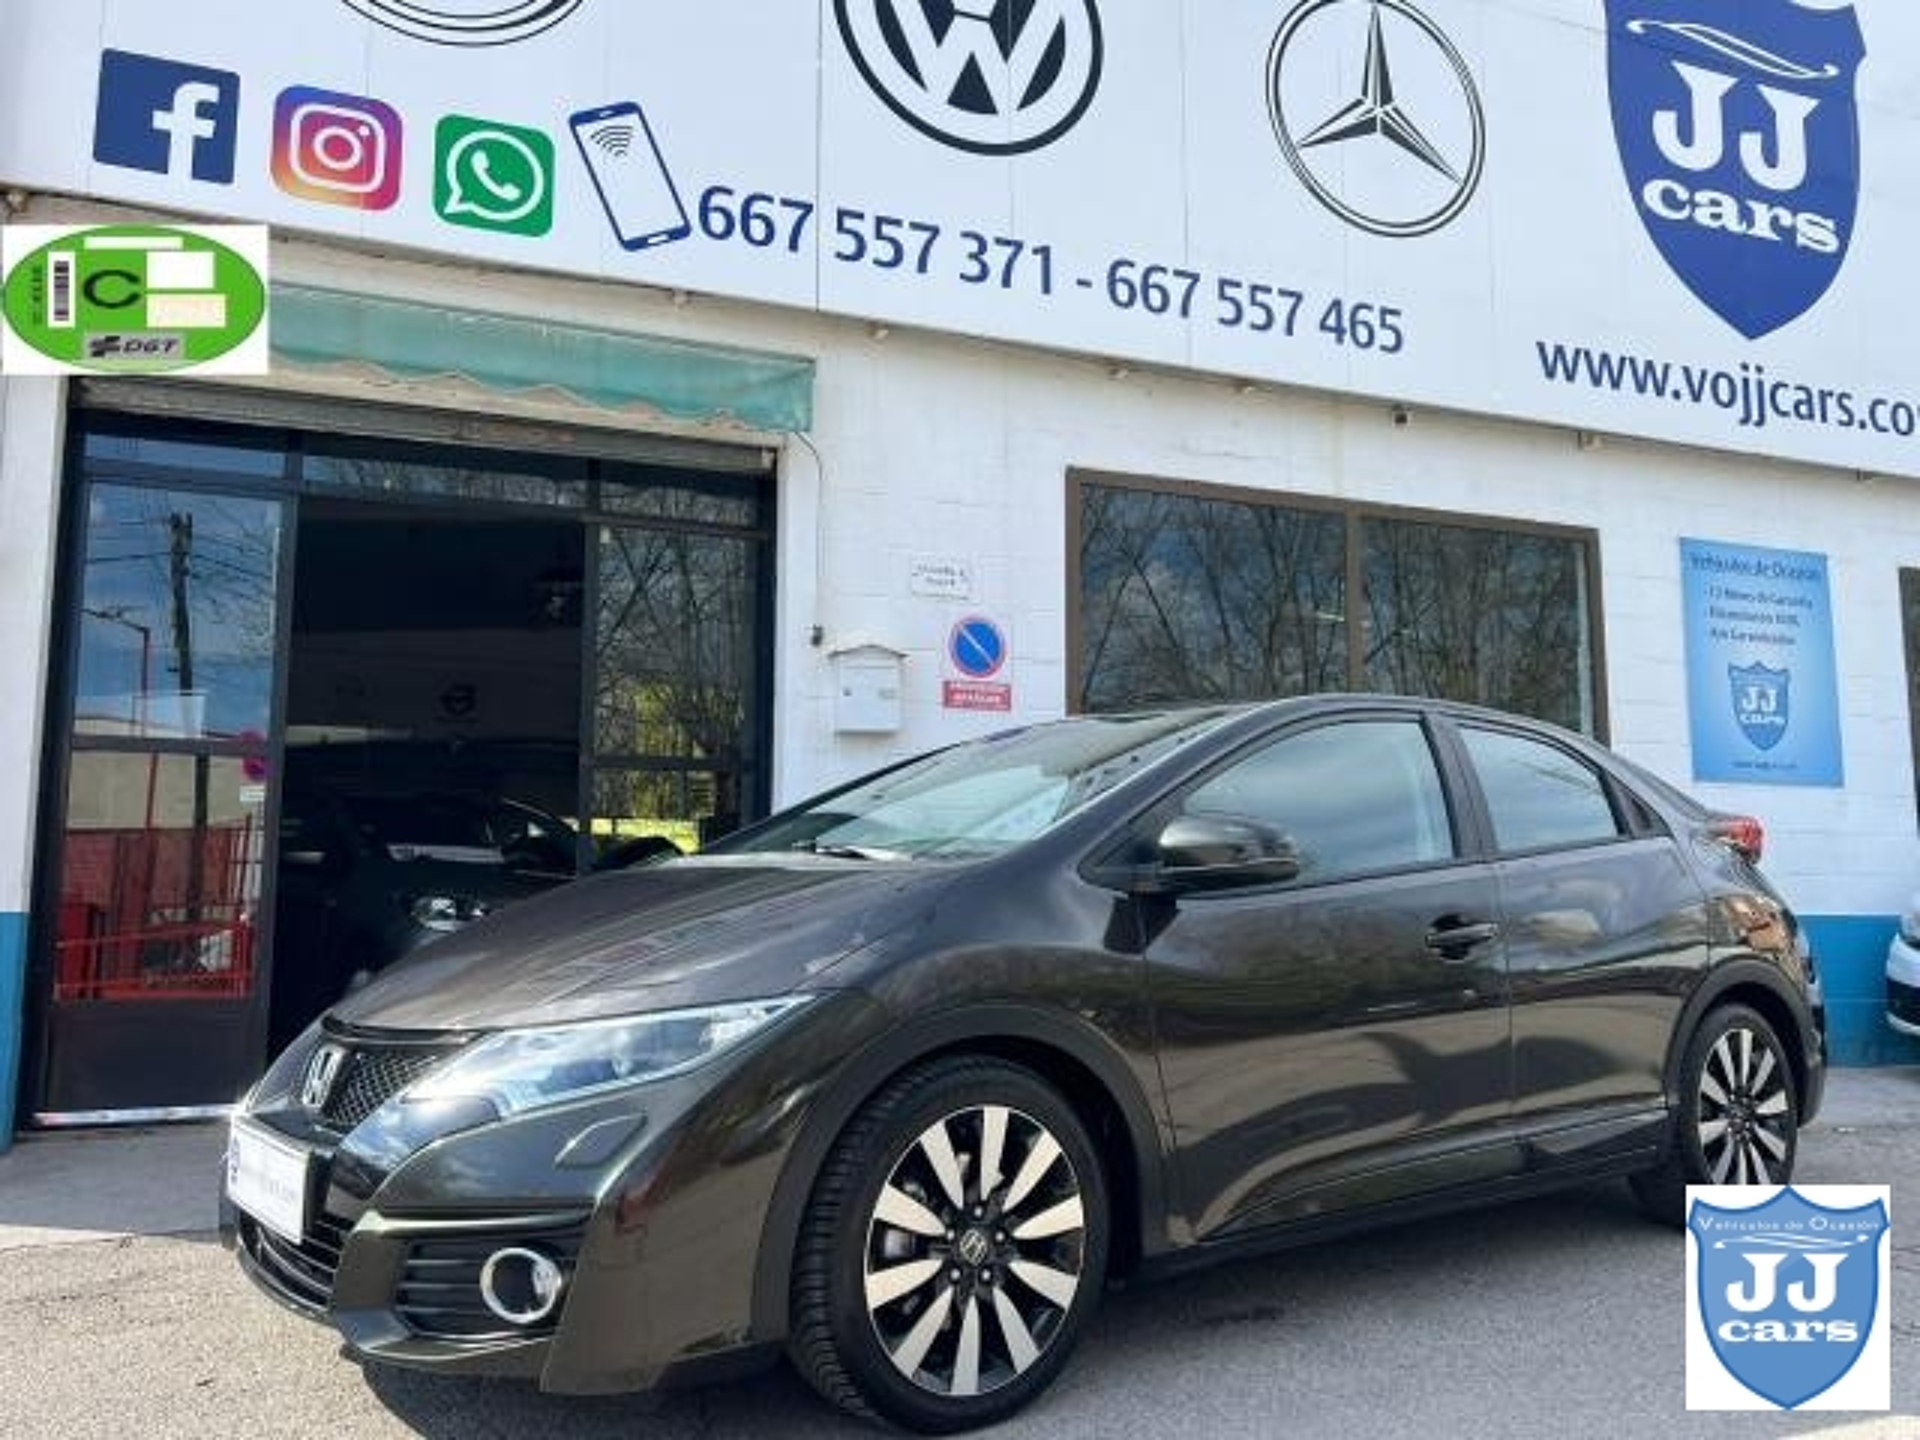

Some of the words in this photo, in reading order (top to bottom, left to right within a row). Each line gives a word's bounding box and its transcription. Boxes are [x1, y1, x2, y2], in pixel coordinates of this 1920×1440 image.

[1652, 60, 1821, 191] JJ
[1642, 179, 1840, 254] cars
[698, 185, 814, 253] 667
[834, 207, 941, 274] 557
[959, 231, 1051, 295] 371
[1106, 259, 1201, 318] 667
[1218, 278, 1304, 337] 557
[1319, 298, 1404, 354] 465
[1536, 340, 1920, 437] www.vojjcars.co
[1742, 686, 1777, 712] JJ
